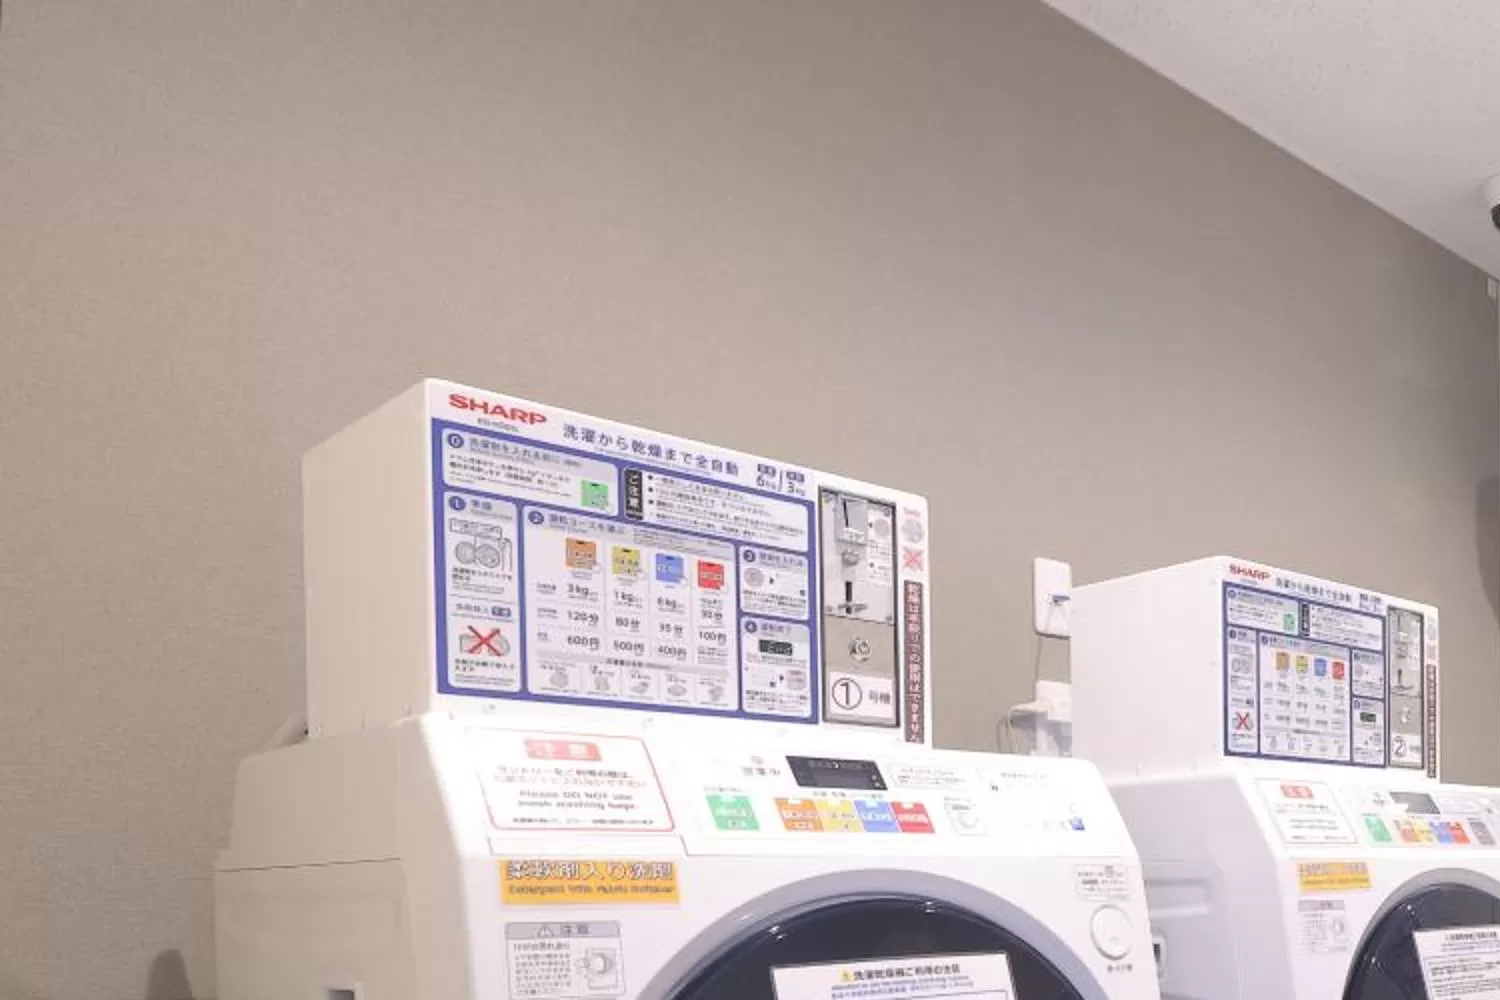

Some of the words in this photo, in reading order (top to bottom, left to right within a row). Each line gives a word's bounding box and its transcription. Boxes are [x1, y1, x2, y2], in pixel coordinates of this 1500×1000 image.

[449, 393, 548, 425] SHARP
[563, 423, 739, 477] 洗濯から乾燥まで全自動
[1229, 564, 1271, 580] SHARP
